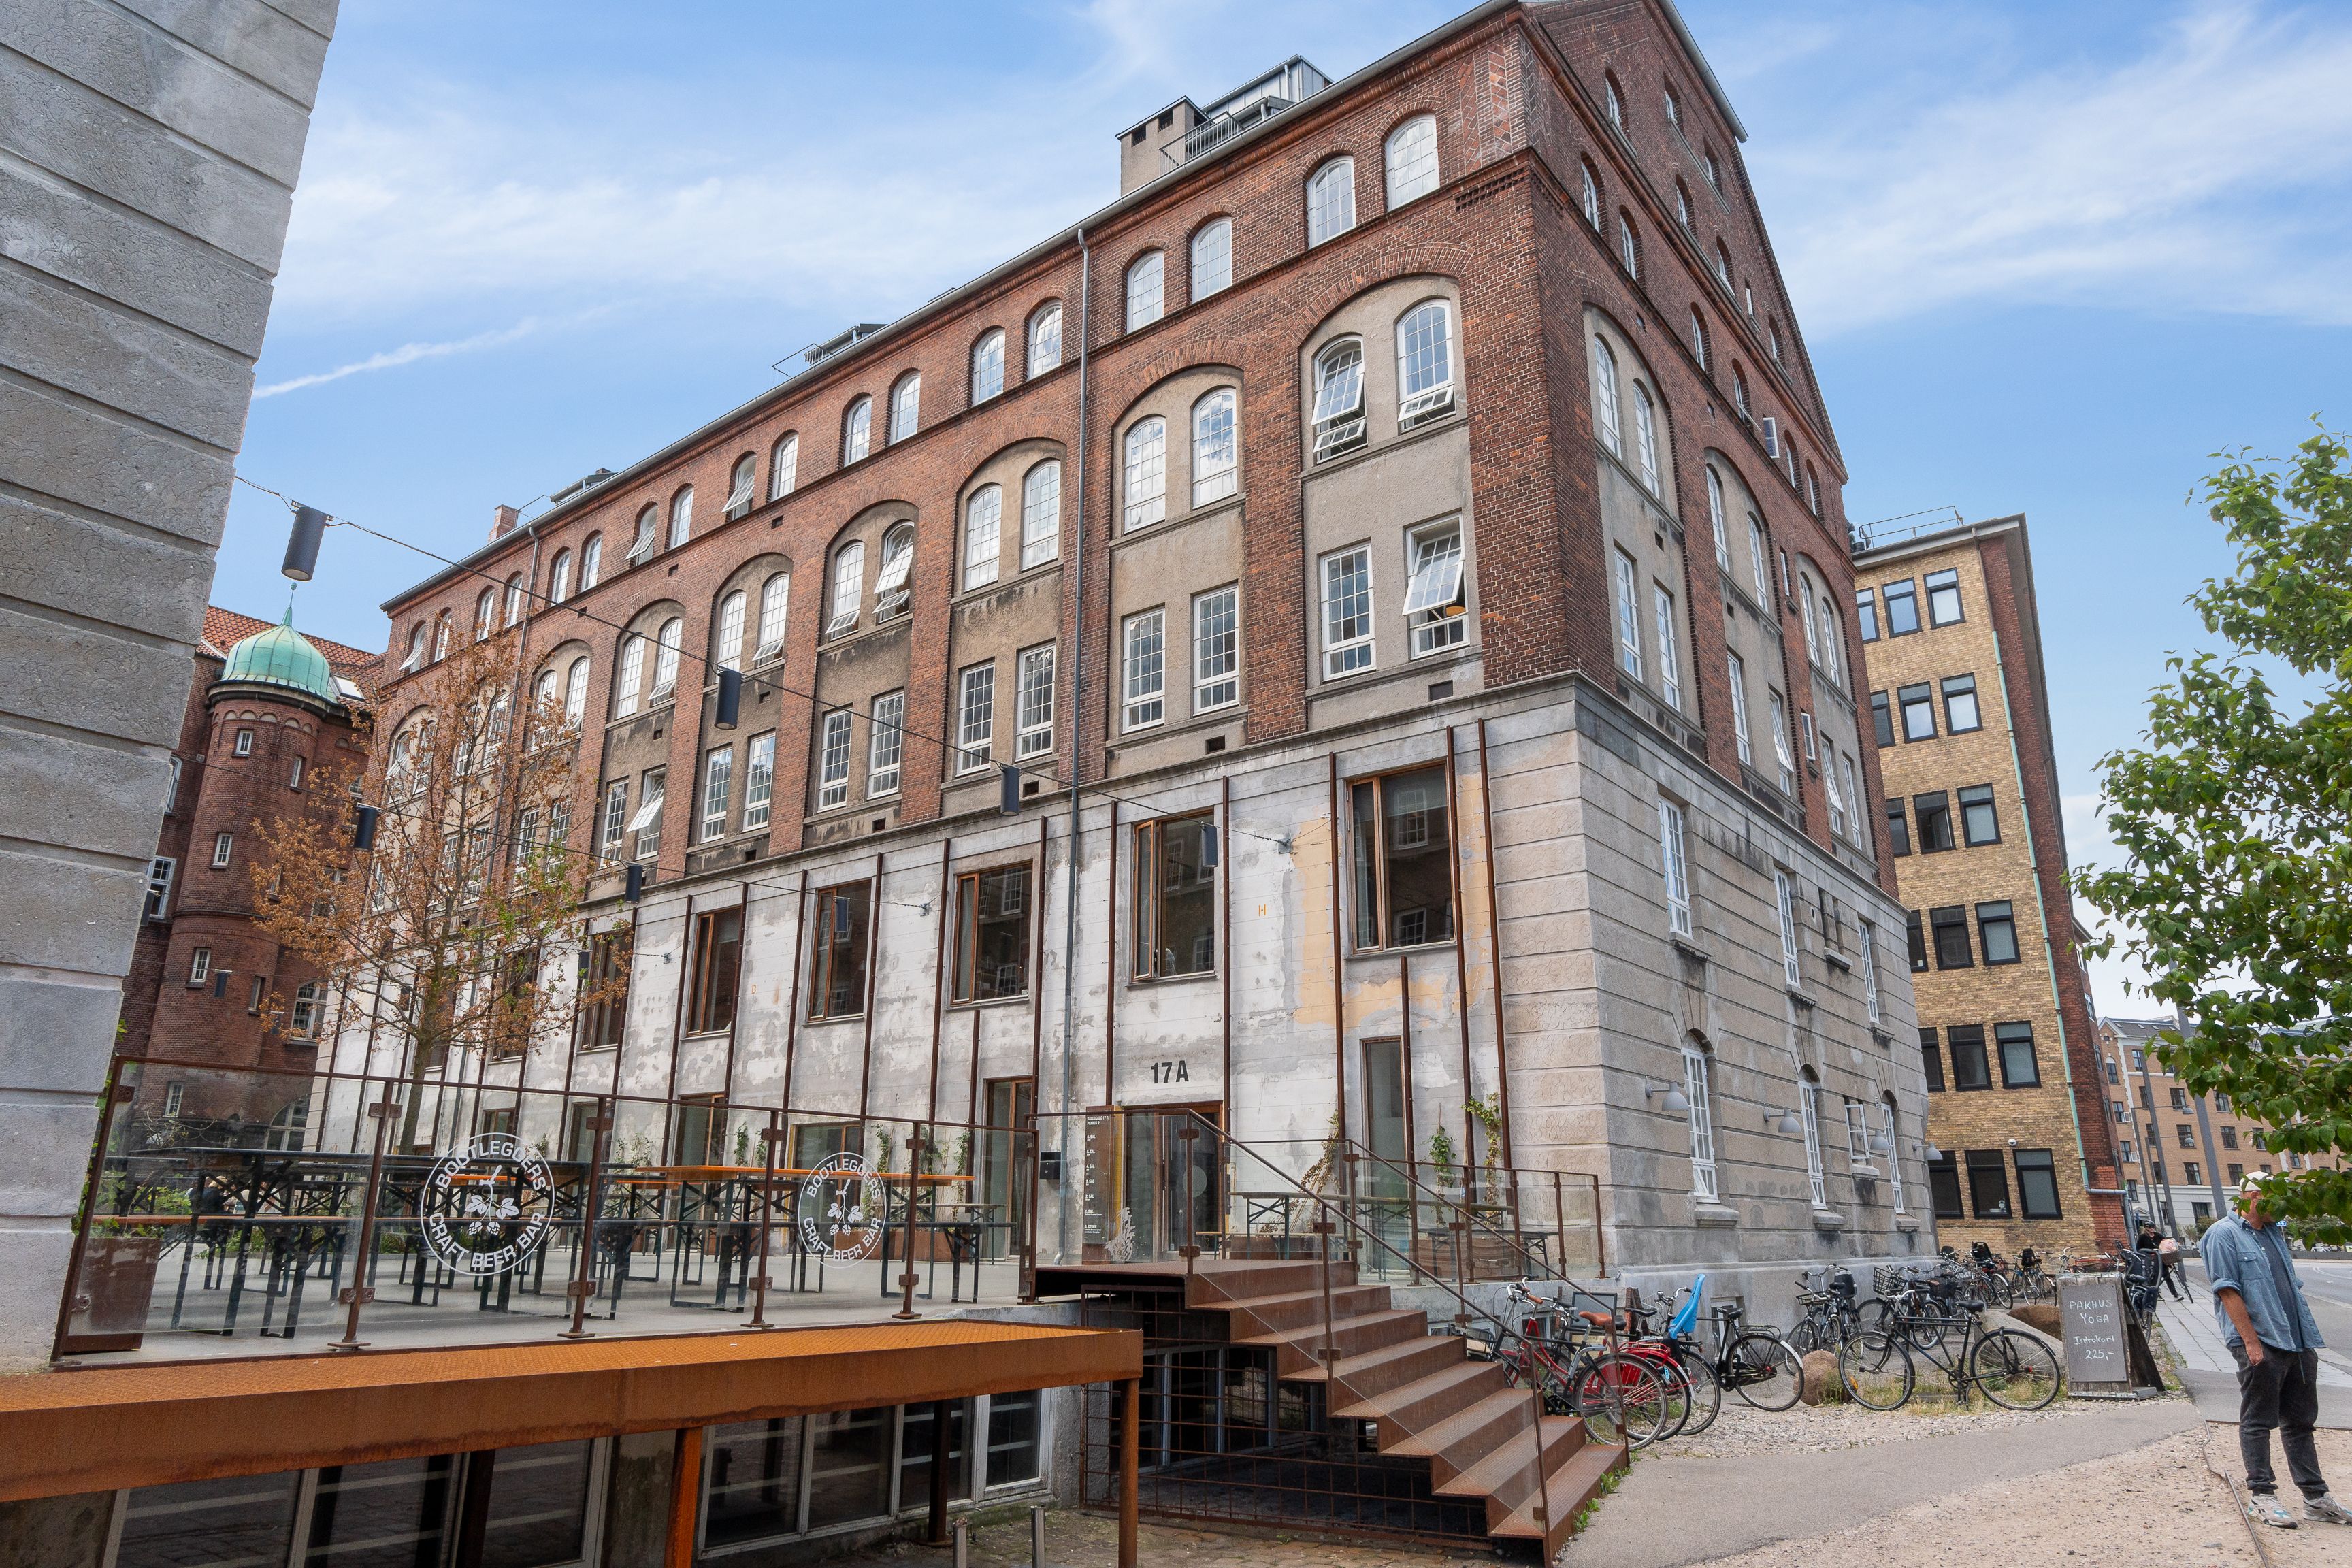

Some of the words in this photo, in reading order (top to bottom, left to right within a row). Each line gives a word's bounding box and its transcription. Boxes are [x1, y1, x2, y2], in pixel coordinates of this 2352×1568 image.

[1151, 1060, 1189, 1084] 17A
[435, 1141, 546, 1191] BOOTLEGGERS
[806, 1158, 881, 1200] BOOTLEGGERS
[429, 1212, 470, 1263] CRAFT
[471, 1245, 517, 1268] BEER
[517, 1211, 546, 1250] BAR
[804, 1216, 832, 1256] CRAFT
[832, 1243, 864, 1262] BEER
[862, 1217, 881, 1248] BAR
[2070, 1299, 2112, 1311] PAKHUS
[2080, 1312, 2110, 1324] YOGA
